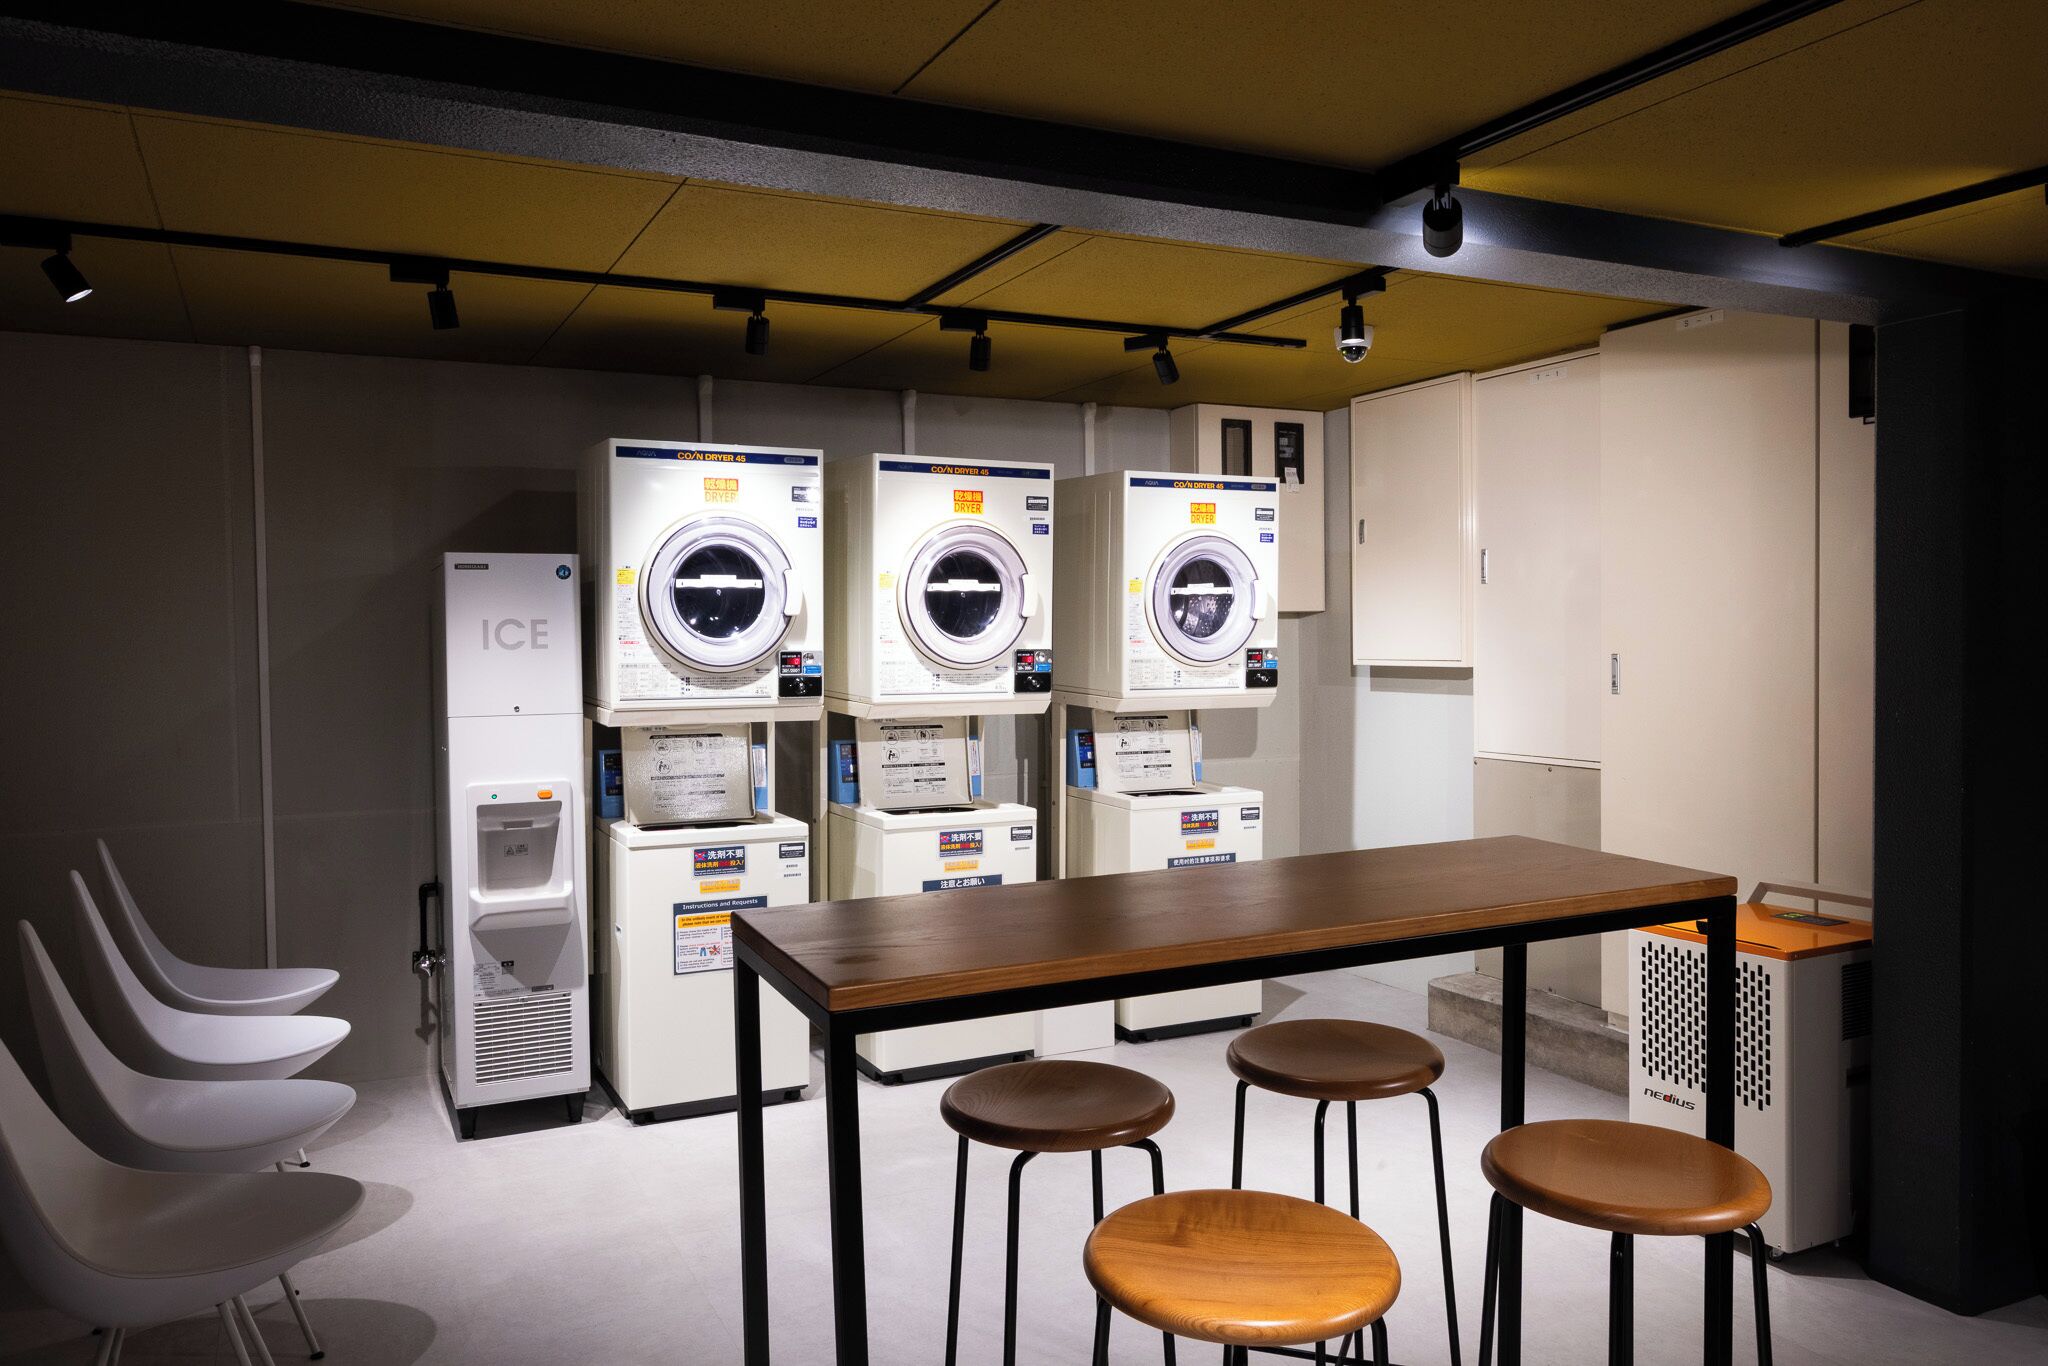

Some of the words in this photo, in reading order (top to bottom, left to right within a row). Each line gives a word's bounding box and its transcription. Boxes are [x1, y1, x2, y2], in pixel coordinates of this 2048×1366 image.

[705, 453, 734, 462] DRYER
[735, 455, 746, 463] 45
[954, 467, 979, 476] DRYER
[980, 468, 989, 476] 45
[704, 491, 738, 503] DRYER
[954, 502, 982, 514] DRYER
[1191, 514, 1215, 524] DRYER
[482, 618, 549, 650] ICE
[950, 831, 982, 842] 洗剤不要
[707, 849, 744, 860] 洗剤不要
[940, 877, 985, 889] 注意とお願い
[682, 902, 719, 910] Instructions
